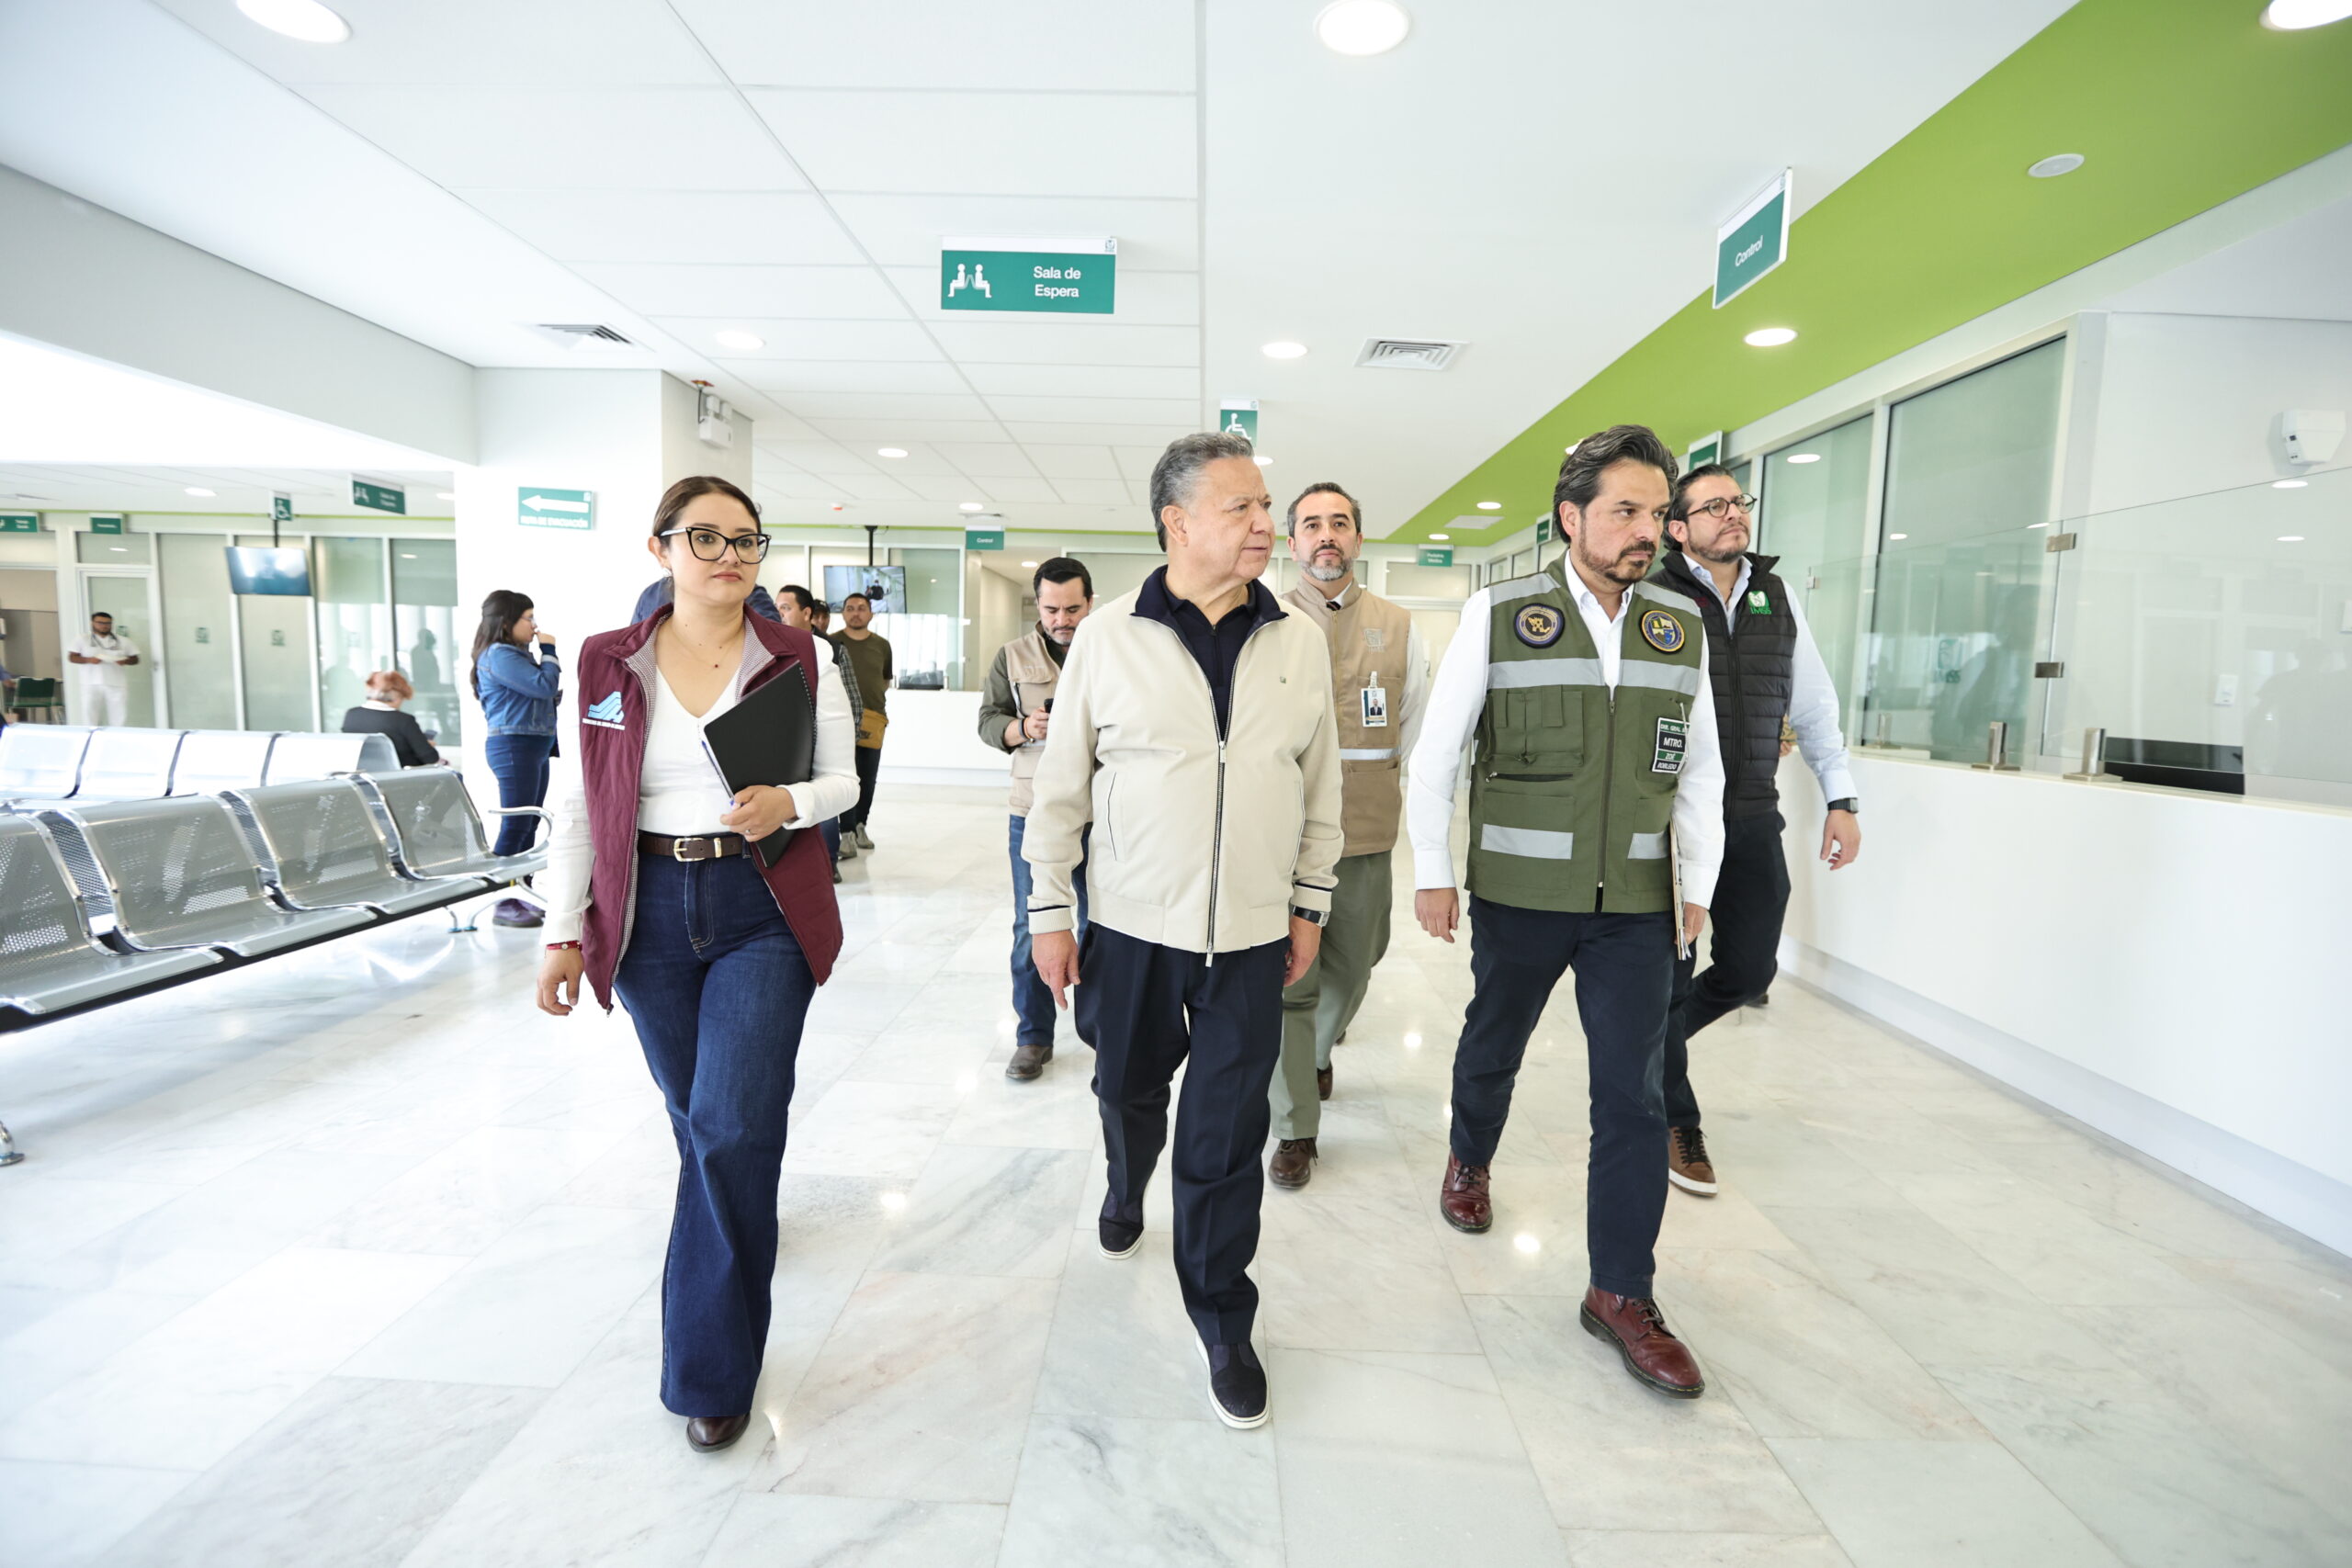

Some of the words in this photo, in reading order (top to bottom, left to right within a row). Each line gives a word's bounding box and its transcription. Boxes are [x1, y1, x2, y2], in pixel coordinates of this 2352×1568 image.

[1735, 234, 1763, 267] Control
[1034, 265, 1062, 279] Sala
[1064, 267, 1081, 279] de
[1035, 284, 1080, 299] Espera
[1750, 606, 1772, 615] IMSS
[1663, 737, 1683, 748] MTRO.
